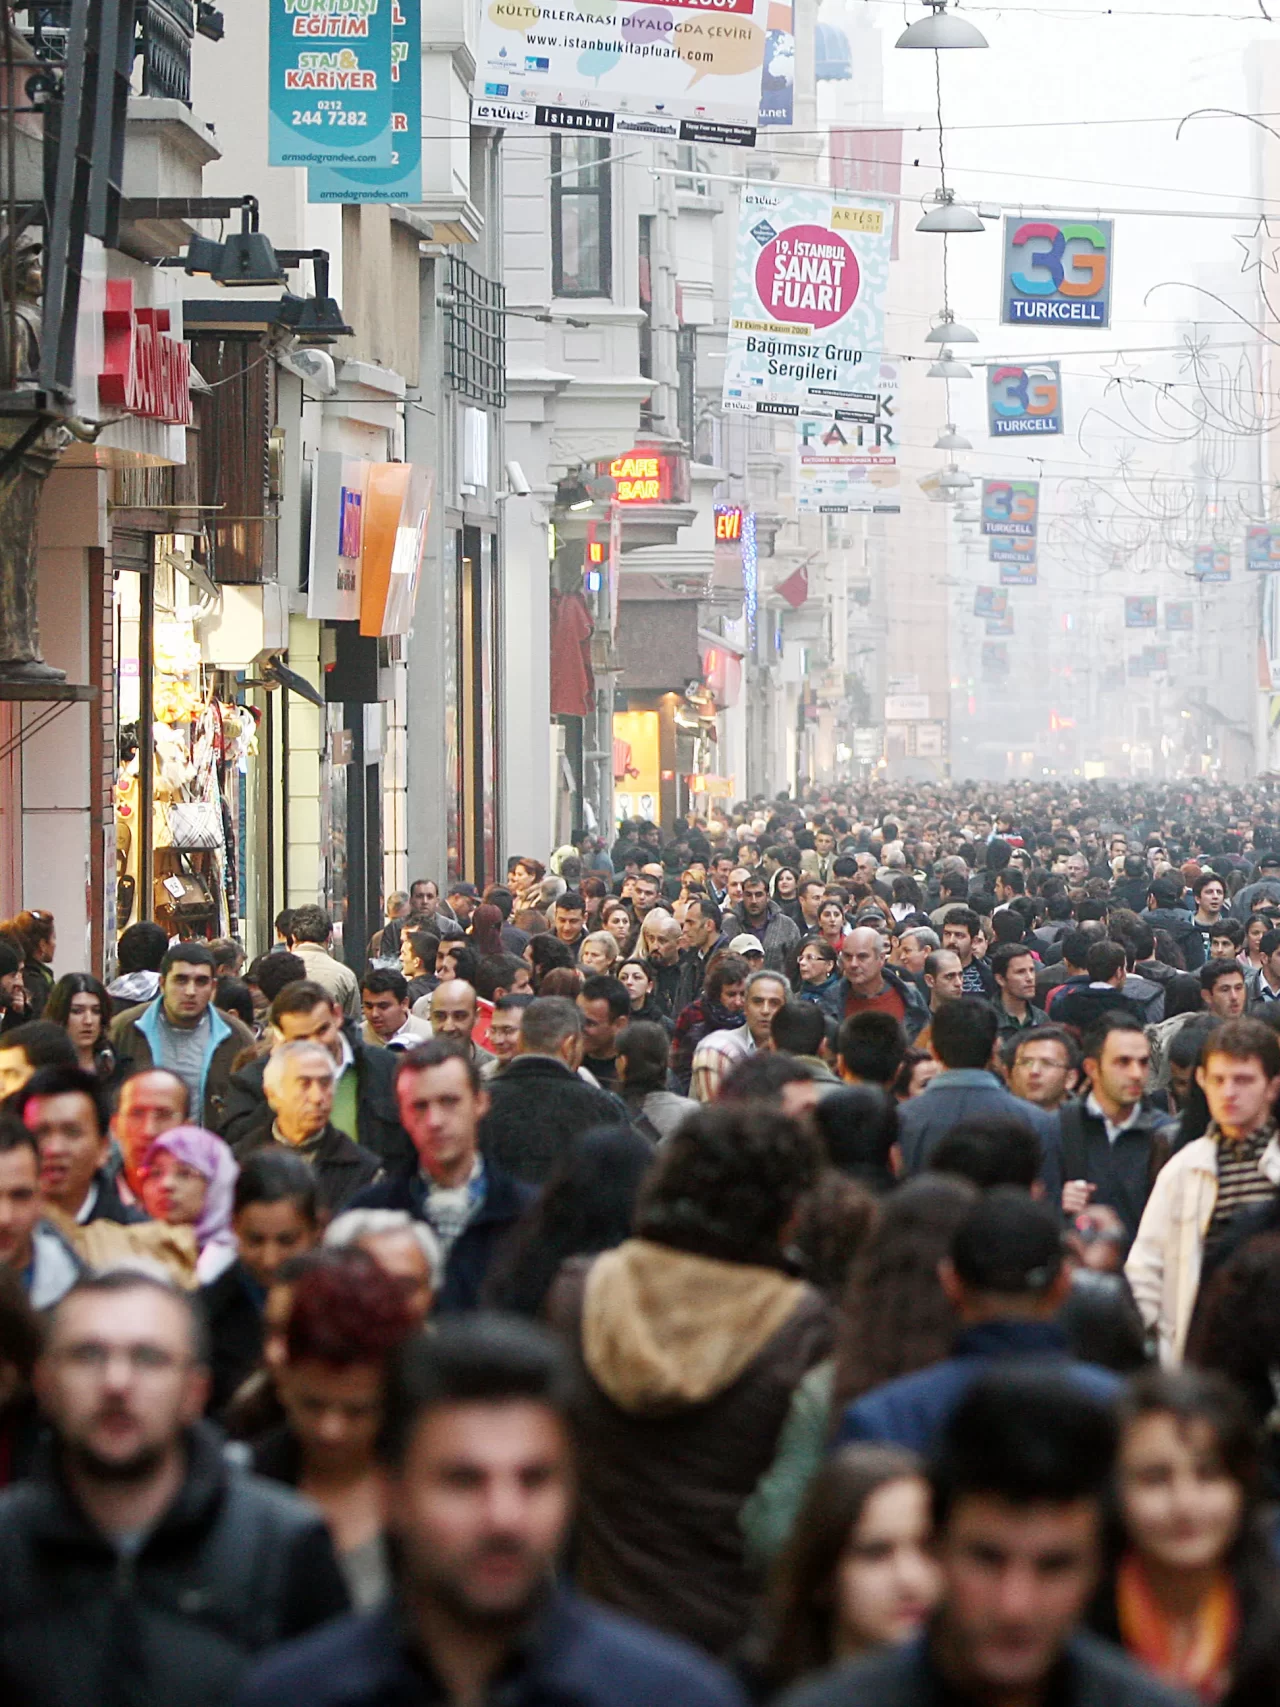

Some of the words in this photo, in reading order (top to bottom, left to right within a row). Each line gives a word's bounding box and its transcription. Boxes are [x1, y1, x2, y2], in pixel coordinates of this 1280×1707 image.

[294, 14, 368, 35] EĞİTİM
[317, 100, 342, 110] 0212
[292, 111, 322, 126] 244
[327, 111, 367, 126] 7282
[775, 240, 791, 255] 19.
[1011, 222, 1106, 297] 3G
[773, 255, 846, 286] SANAT
[771, 280, 842, 312] FUARI
[1014, 301, 1100, 320] TURKCELL
[746, 335, 820, 358] Bağımsız
[825, 344, 862, 366] Grup
[768, 359, 838, 381] Sergileri
[992, 365, 1057, 416] 3G
[802, 423, 895, 446] FAIR
[996, 420, 1057, 431] TURKCELL
[611, 458, 659, 478] CAFE
[618, 480, 659, 500] BAR
[984, 482, 1036, 522] 3G
[985, 522, 1032, 534] TURKCELL
